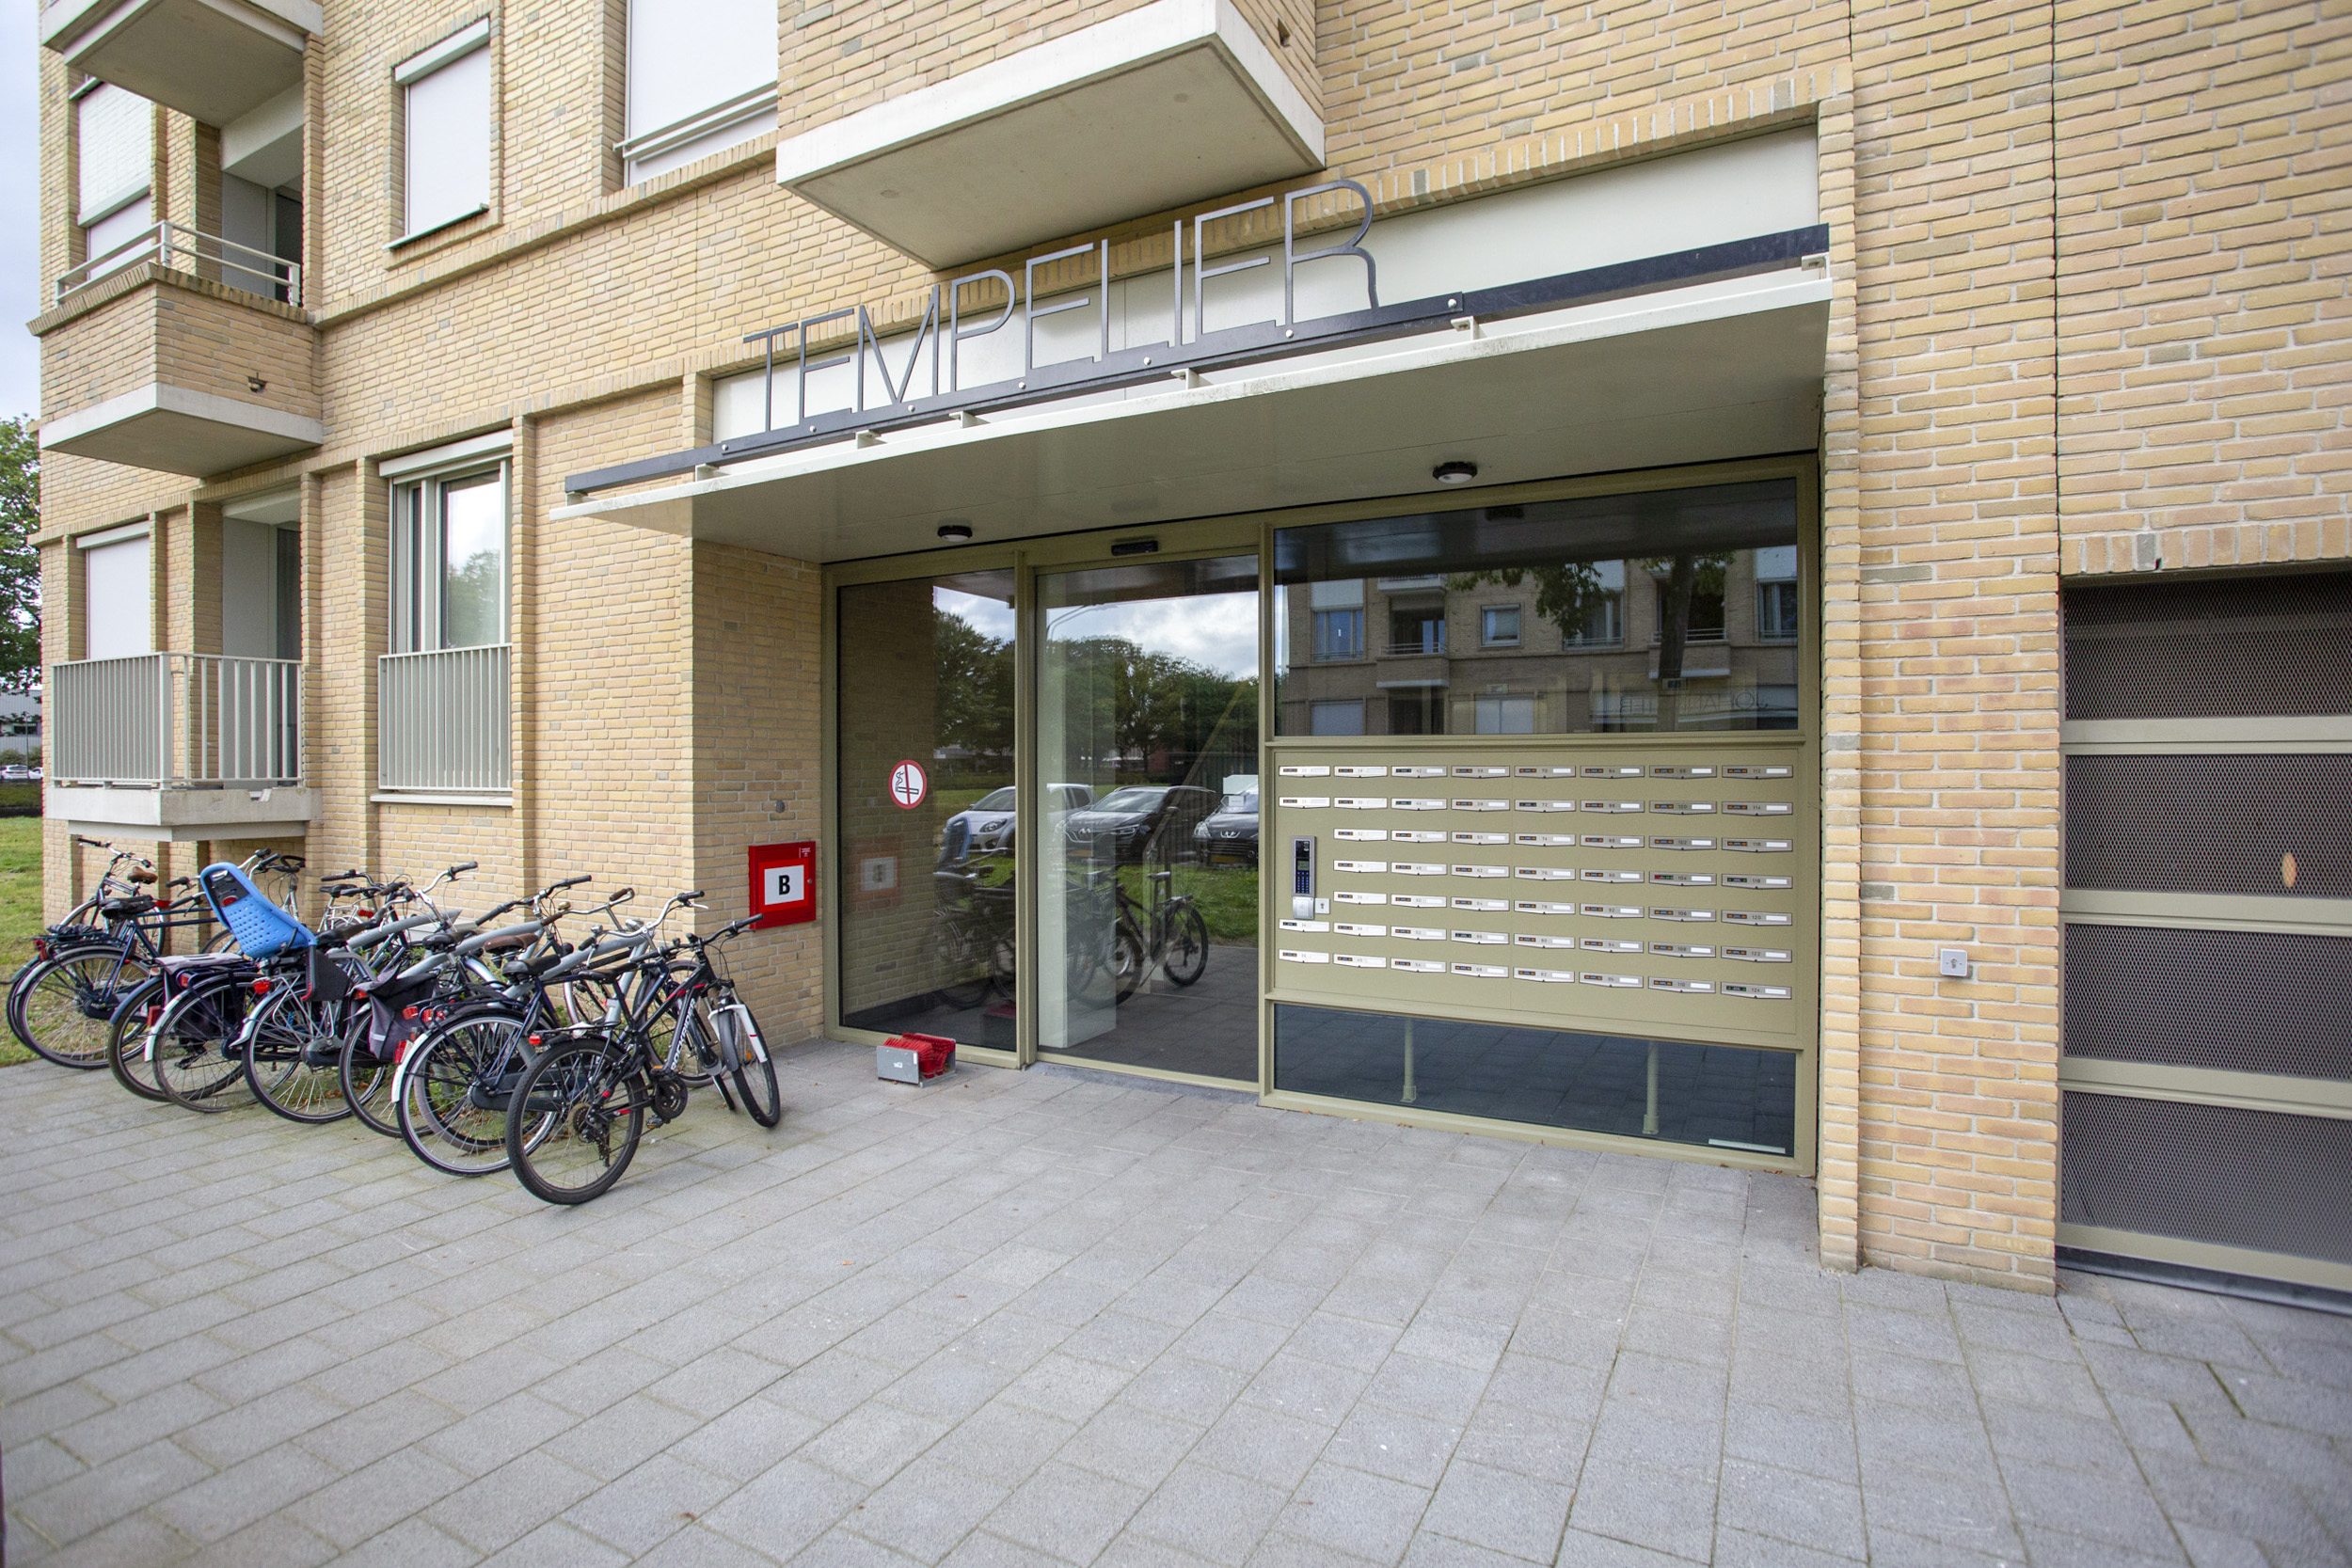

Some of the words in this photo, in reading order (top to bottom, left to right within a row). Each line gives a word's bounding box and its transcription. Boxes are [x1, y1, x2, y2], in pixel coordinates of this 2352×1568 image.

[742, 179, 1380, 433] TEMPELIER
[778, 875, 790, 895] B
[670, 997, 696, 1070] ROCKRIDER
